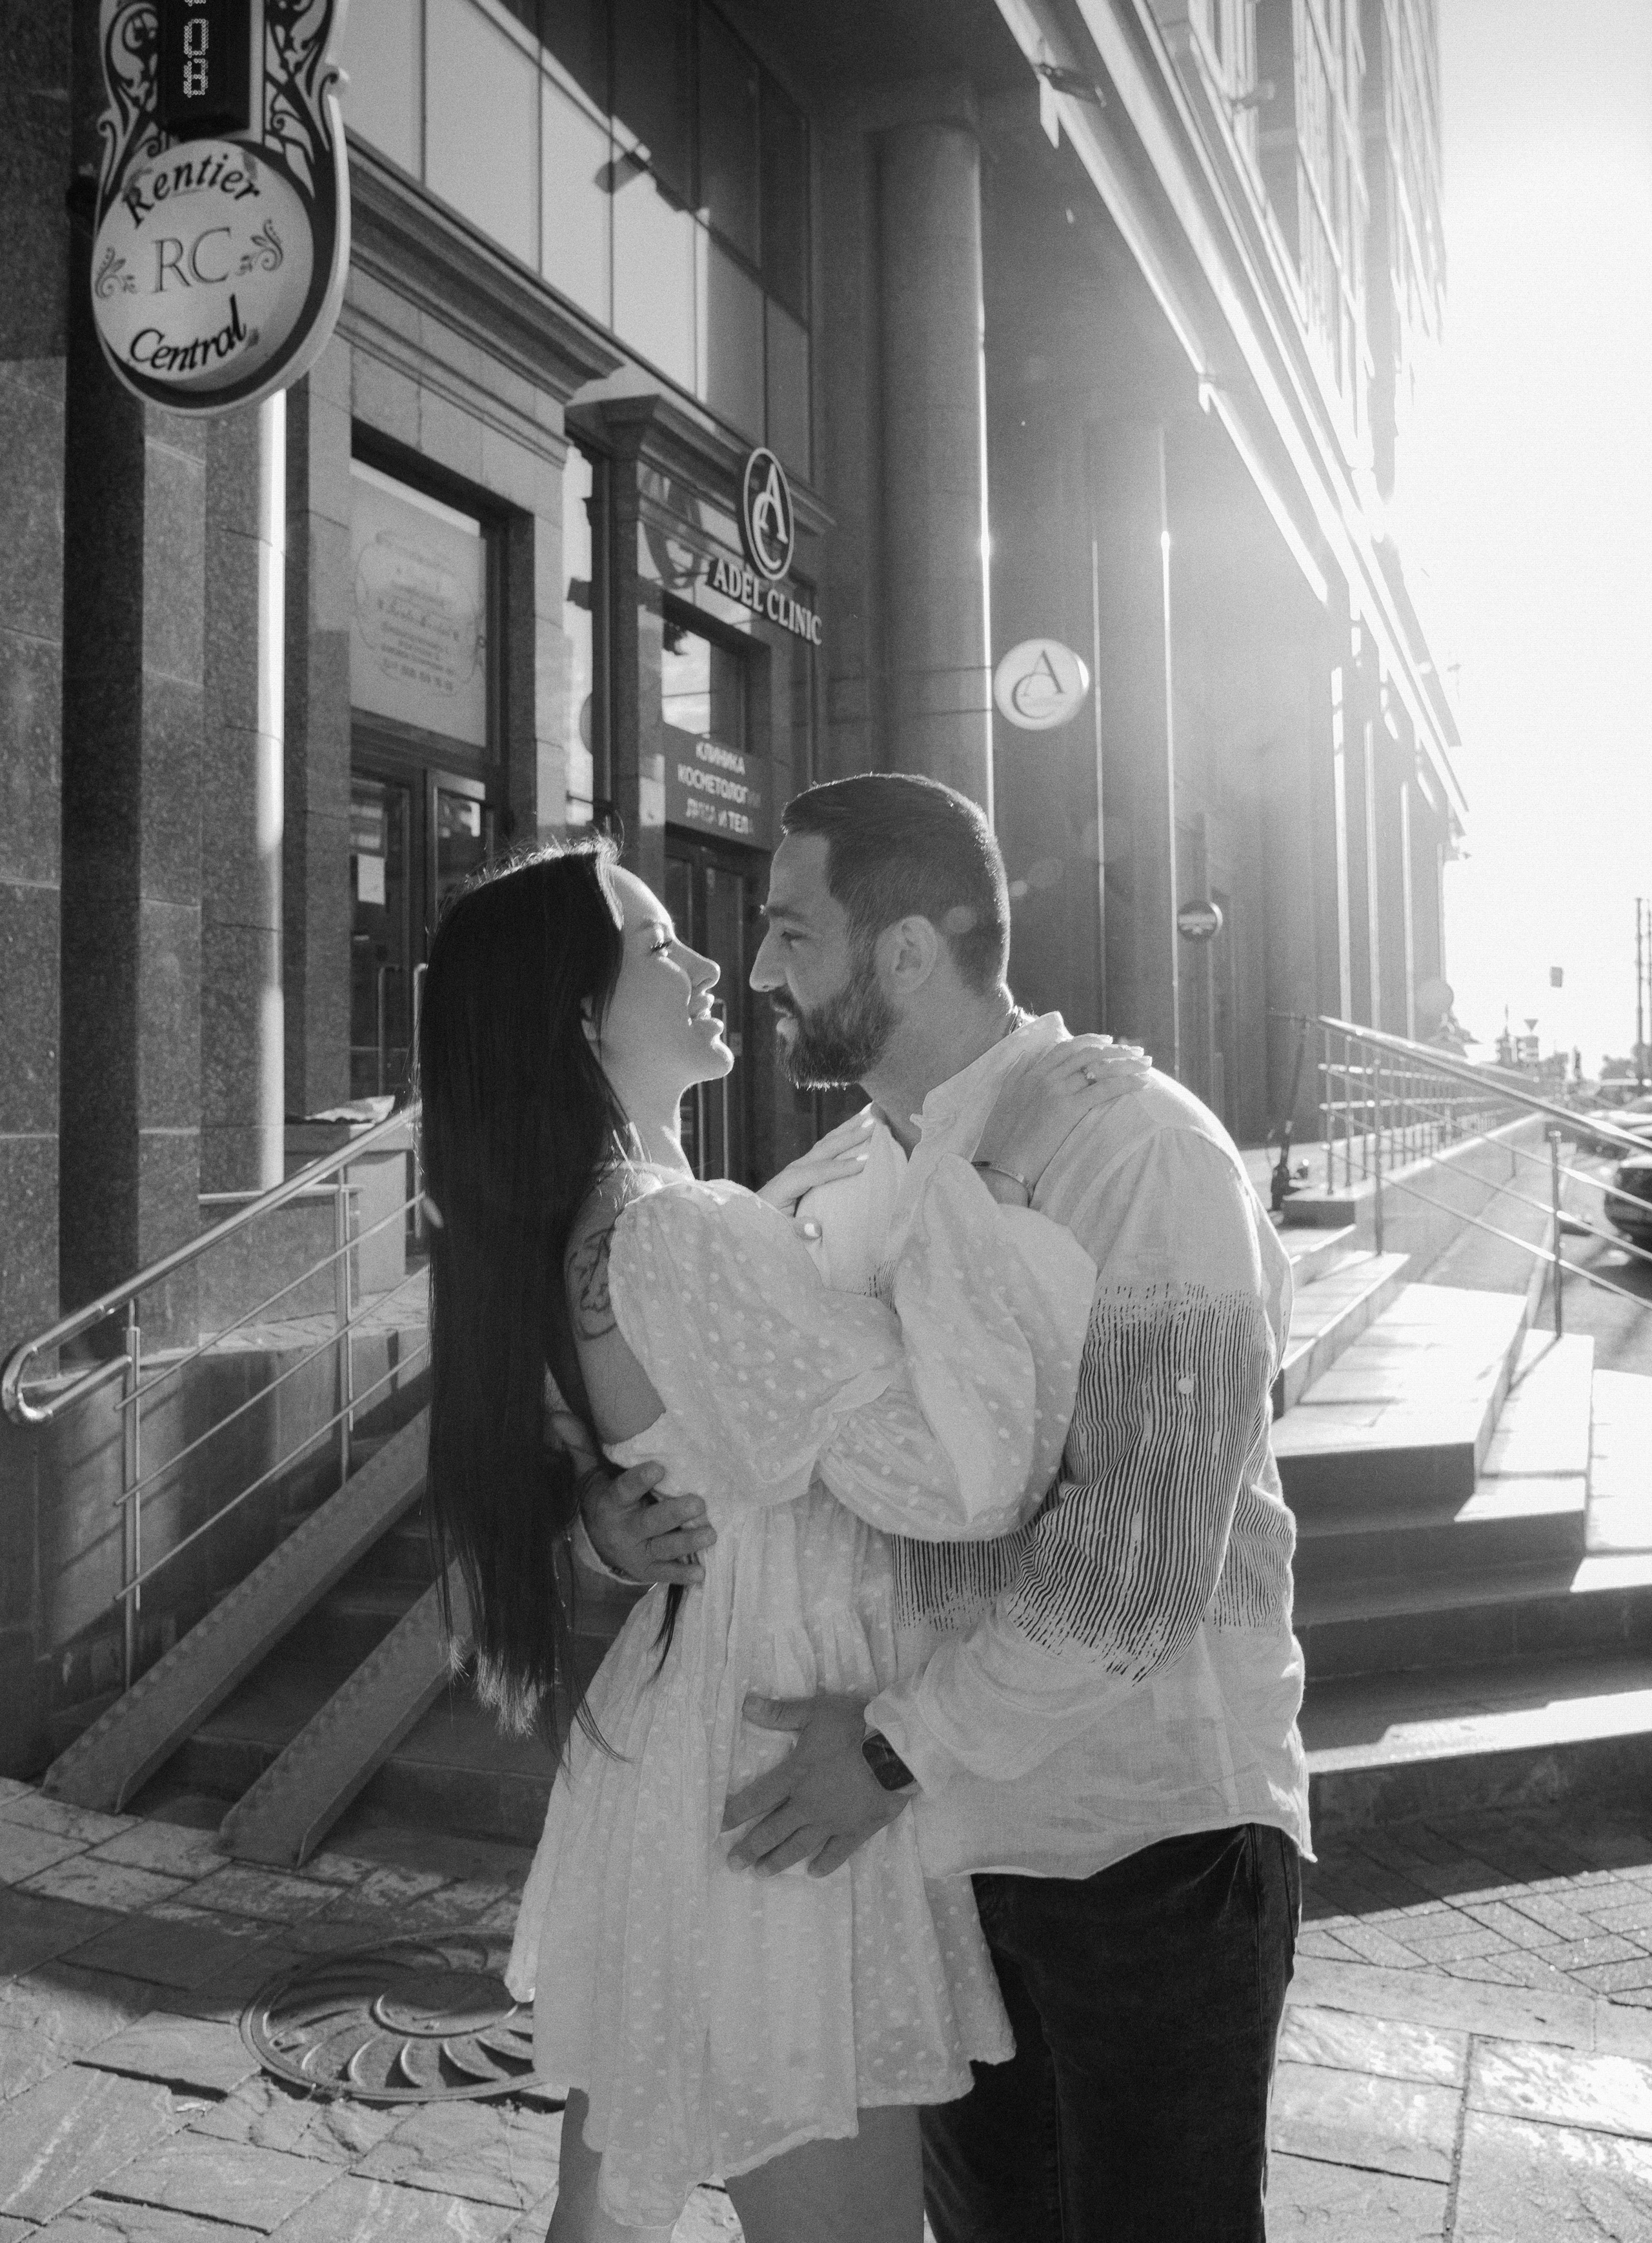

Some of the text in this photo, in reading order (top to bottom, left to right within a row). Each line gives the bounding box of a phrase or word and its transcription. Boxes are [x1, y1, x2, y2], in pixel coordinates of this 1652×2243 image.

[121, 154, 261, 230] Rentier
[150, 226, 232, 294] RC
[130, 294, 248, 372] Central
[712, 557, 823, 646] ADEL CLINIC
